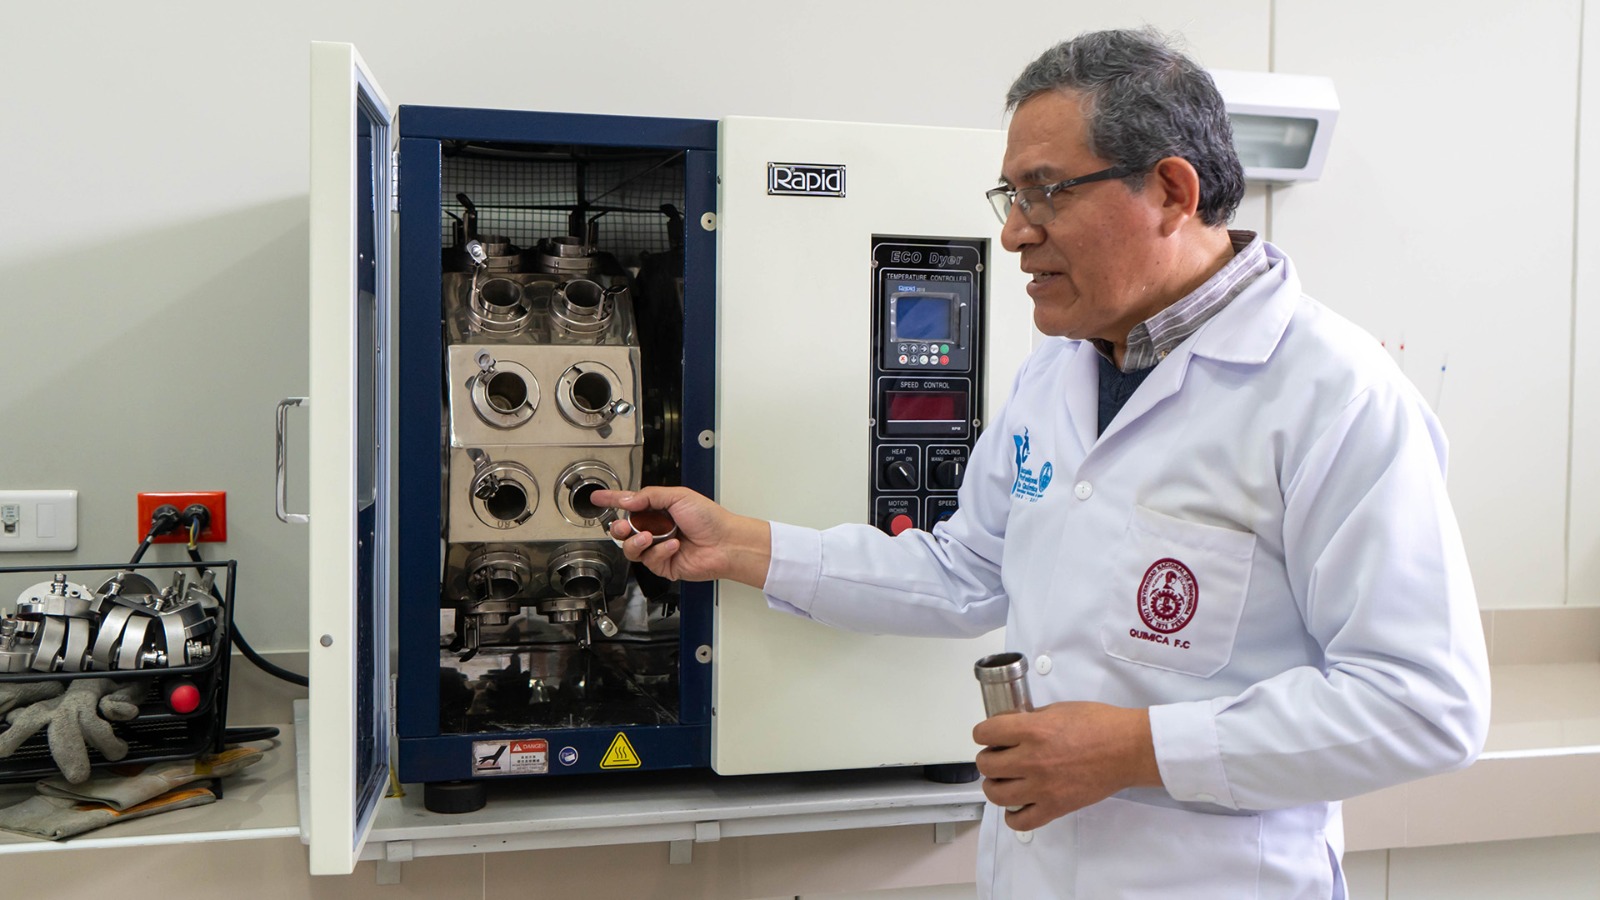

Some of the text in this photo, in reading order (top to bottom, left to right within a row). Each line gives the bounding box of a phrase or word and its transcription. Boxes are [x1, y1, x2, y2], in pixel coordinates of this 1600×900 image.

[773, 167, 841, 192] Rapid
[890, 250, 963, 267] ECO Dyer
[900, 381, 950, 389] SPEED CONTROL
[1129, 628, 1170, 646] QUIMICA
